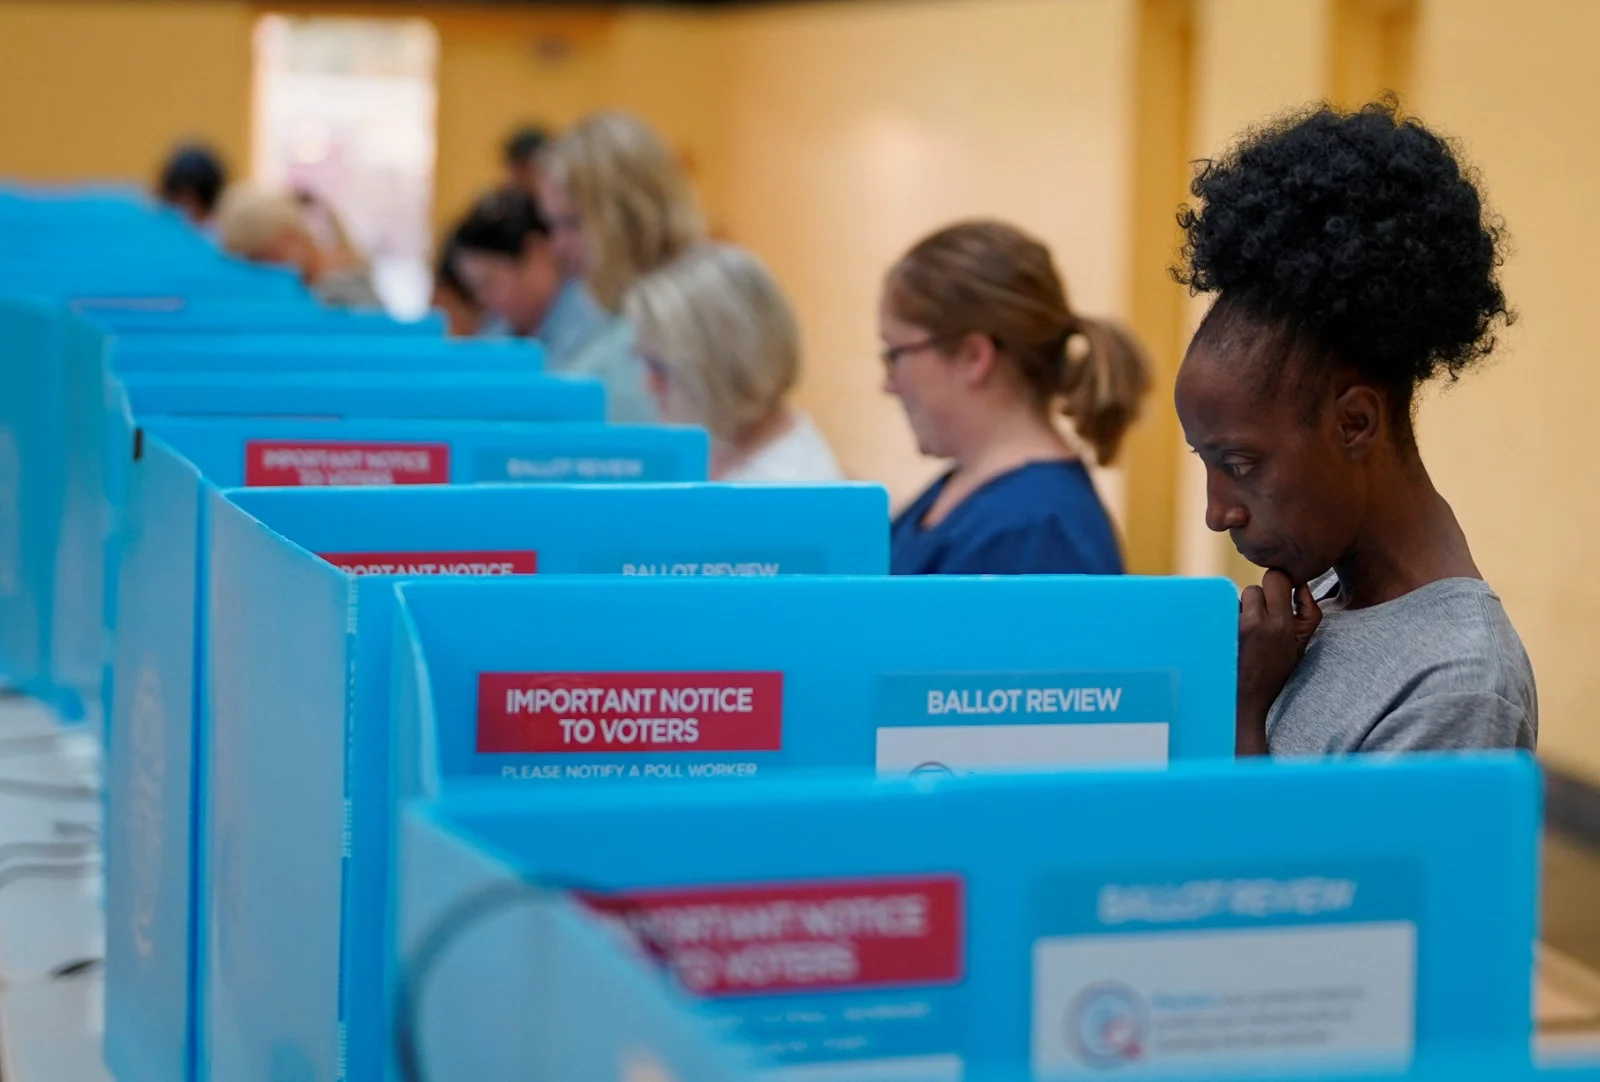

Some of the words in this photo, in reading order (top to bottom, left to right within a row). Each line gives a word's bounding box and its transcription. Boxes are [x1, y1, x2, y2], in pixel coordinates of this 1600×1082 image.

[506, 688, 656, 713] IMPORTANT
[660, 687, 753, 712] NOTICE
[926, 689, 1022, 714] BALLOT
[1025, 687, 1122, 712] REVIEW
[559, 719, 595, 743] TO
[601, 718, 700, 743] VOTERS
[502, 766, 562, 779] PLEASE
[566, 765, 626, 778] NOTIFY
[628, 765, 640, 777] A
[644, 765, 684, 777] POLL
[688, 763, 758, 777] WORKER
